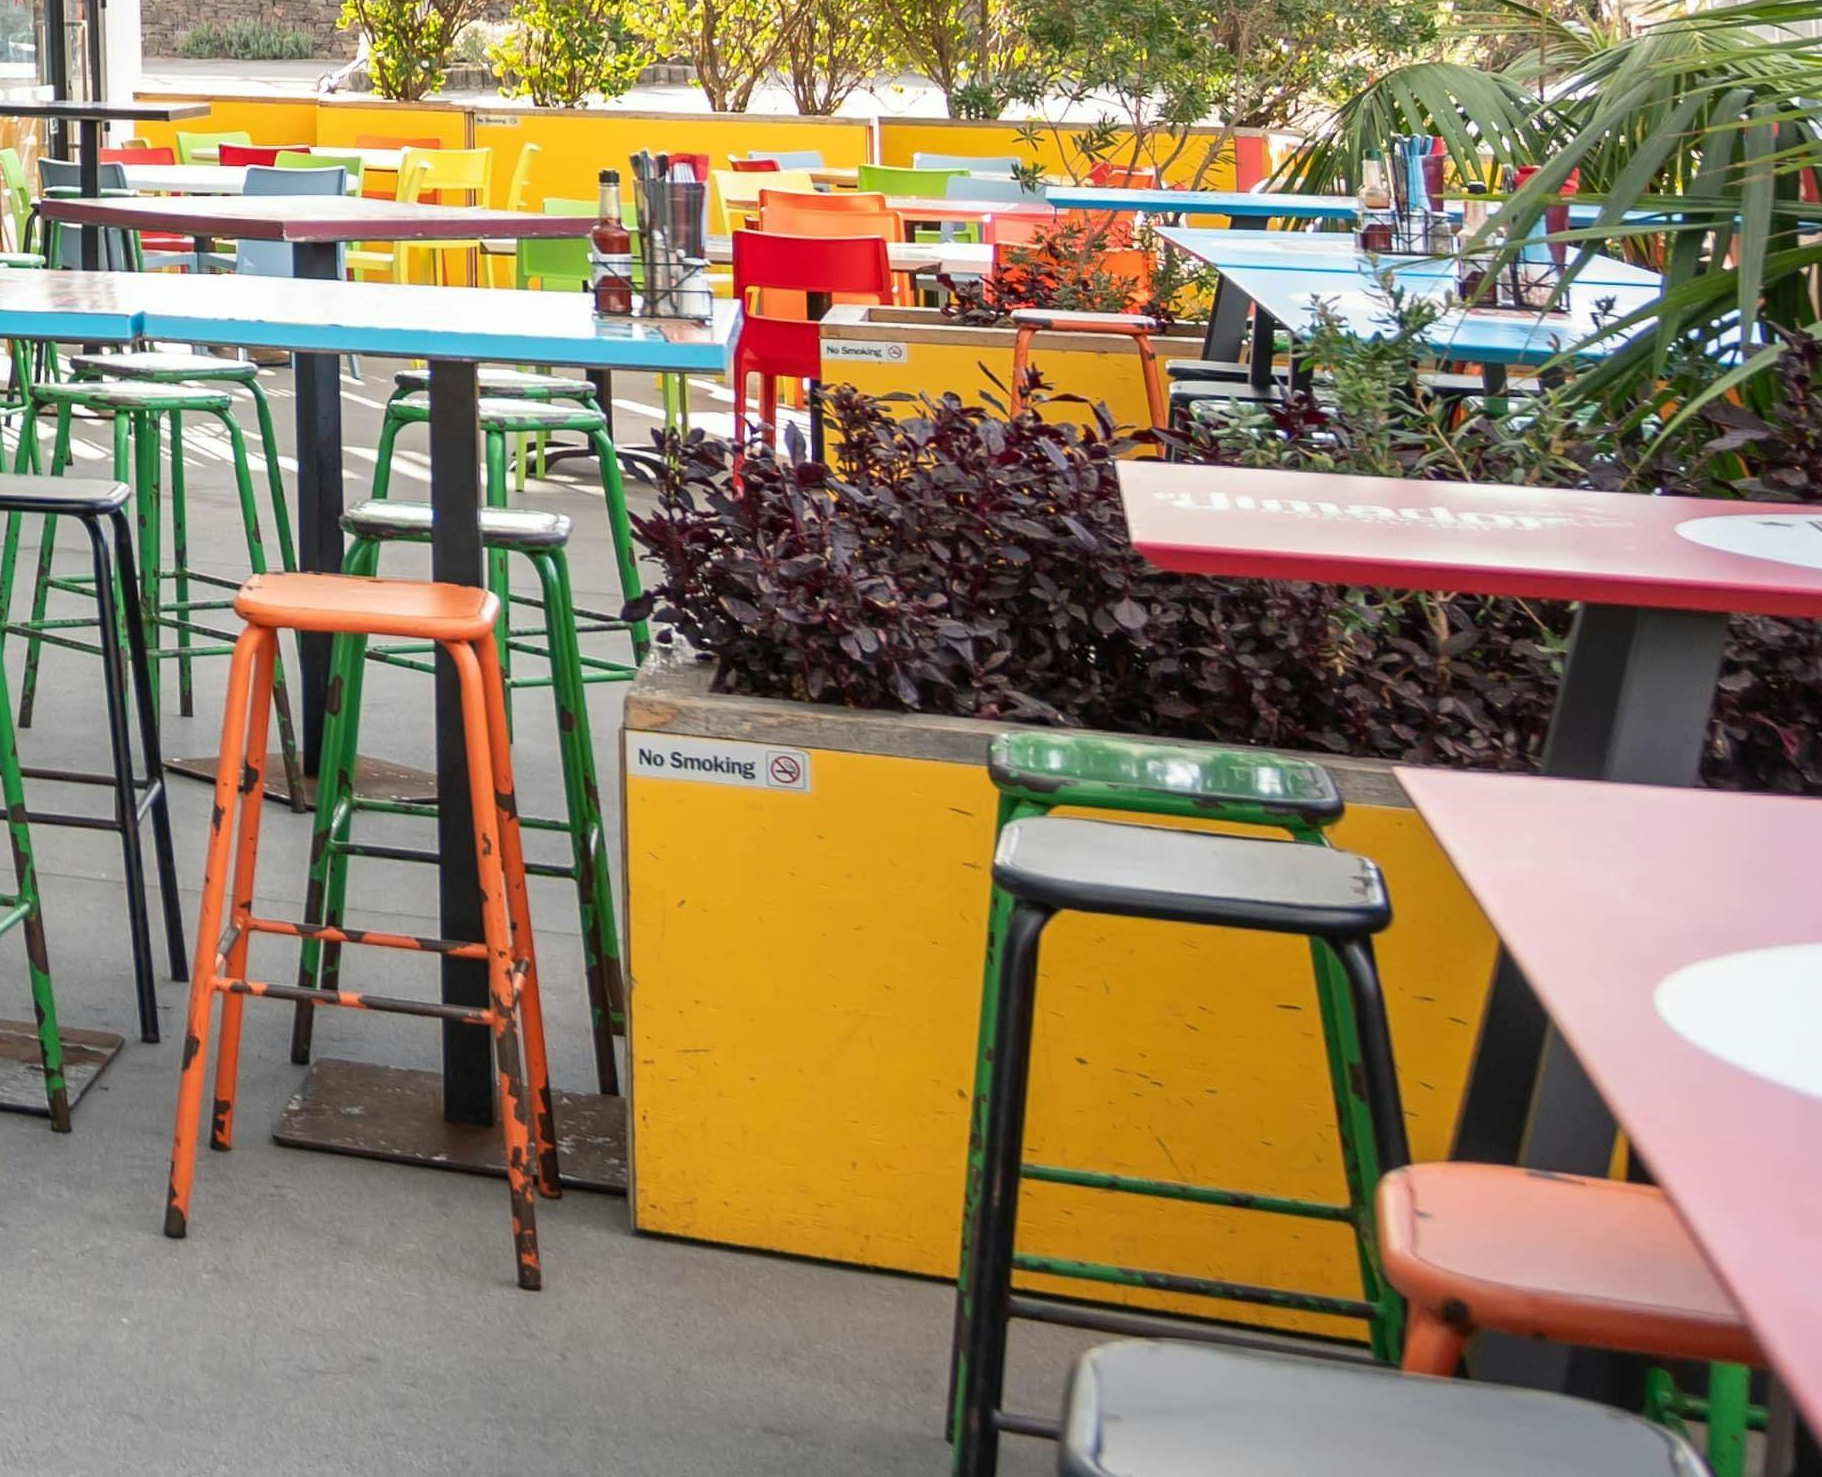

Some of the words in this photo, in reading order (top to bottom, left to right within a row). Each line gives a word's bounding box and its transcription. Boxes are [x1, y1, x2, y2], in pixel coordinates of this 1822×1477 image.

[827, 345, 840, 355] No
[841, 346, 883, 358] Smoking
[638, 748, 665, 767] No
[670, 751, 757, 781] Smoking
